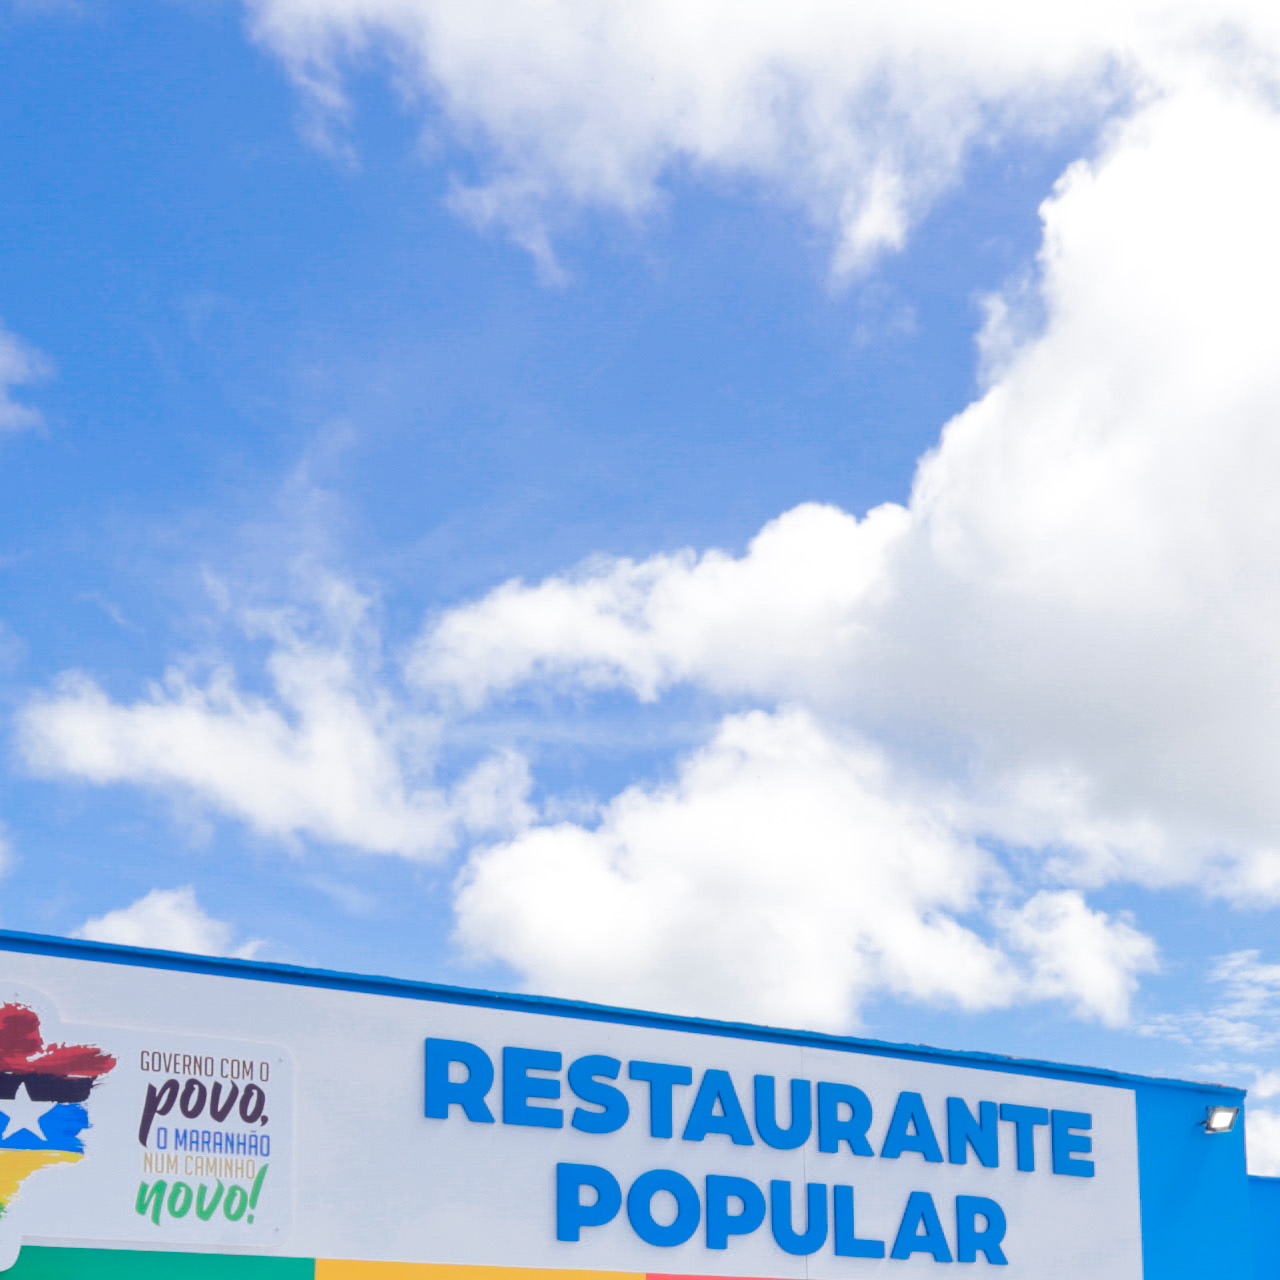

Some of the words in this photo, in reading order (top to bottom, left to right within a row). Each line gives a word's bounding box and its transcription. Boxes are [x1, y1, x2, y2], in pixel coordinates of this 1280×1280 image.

[140, 1050, 214, 1077] GOVERNO
[220, 1058, 254, 1081] COM
[259, 1062, 269, 1082] O
[138, 1078, 269, 1148] povo,
[424, 1037, 1095, 1178] RESTAURANTE
[143, 1152, 179, 1175] NUM
[184, 1155, 256, 1180] CAMINHO
[157, 1127, 168, 1150] O
[174, 1128, 271, 1157] MARANHÃO
[135, 1163, 269, 1226] novo!
[556, 1162, 1009, 1265] POPULAR
